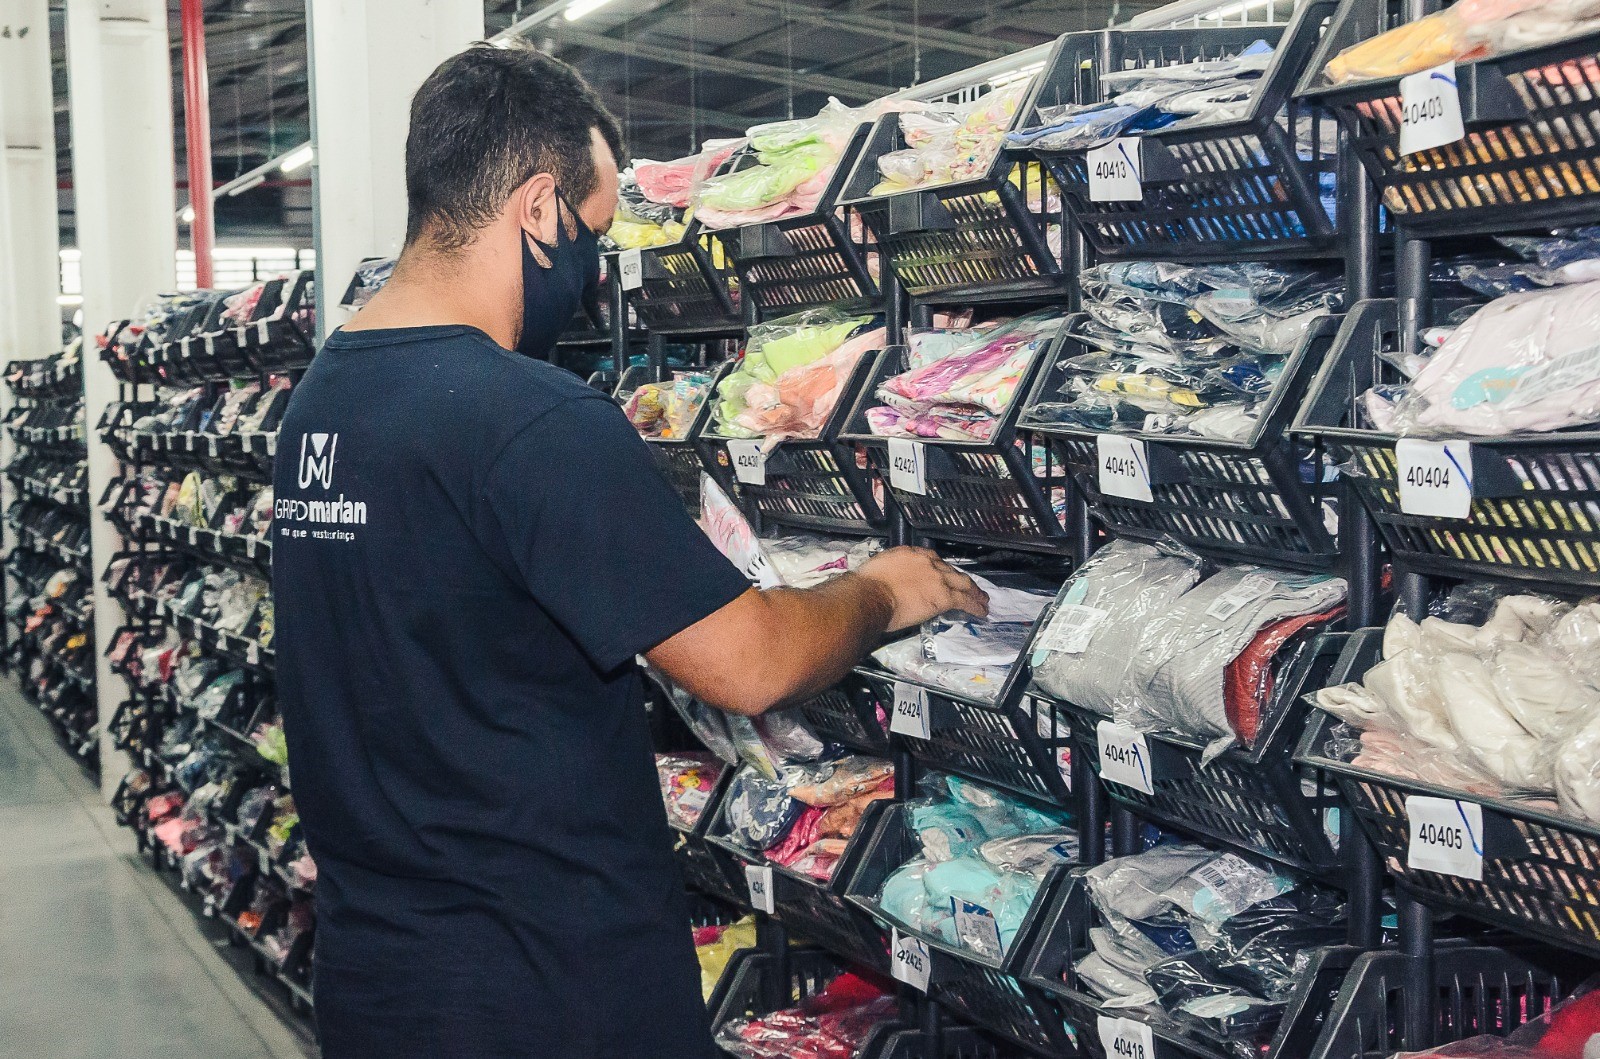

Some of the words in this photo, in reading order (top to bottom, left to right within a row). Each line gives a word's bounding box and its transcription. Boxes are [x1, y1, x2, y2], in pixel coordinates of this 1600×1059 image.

[1402, 96, 1444, 125] 40403
[1096, 161, 1126, 180] 40413
[894, 456, 916, 474] 42423
[1105, 456, 1137, 478] 40415
[1407, 465, 1450, 488] 40404
[898, 700, 920, 719] 42424
[1105, 743, 1139, 768] 40417
[1418, 823, 1463, 850] 40405
[896, 949, 923, 973] 42425
[1113, 1036, 1145, 1059] 40418
